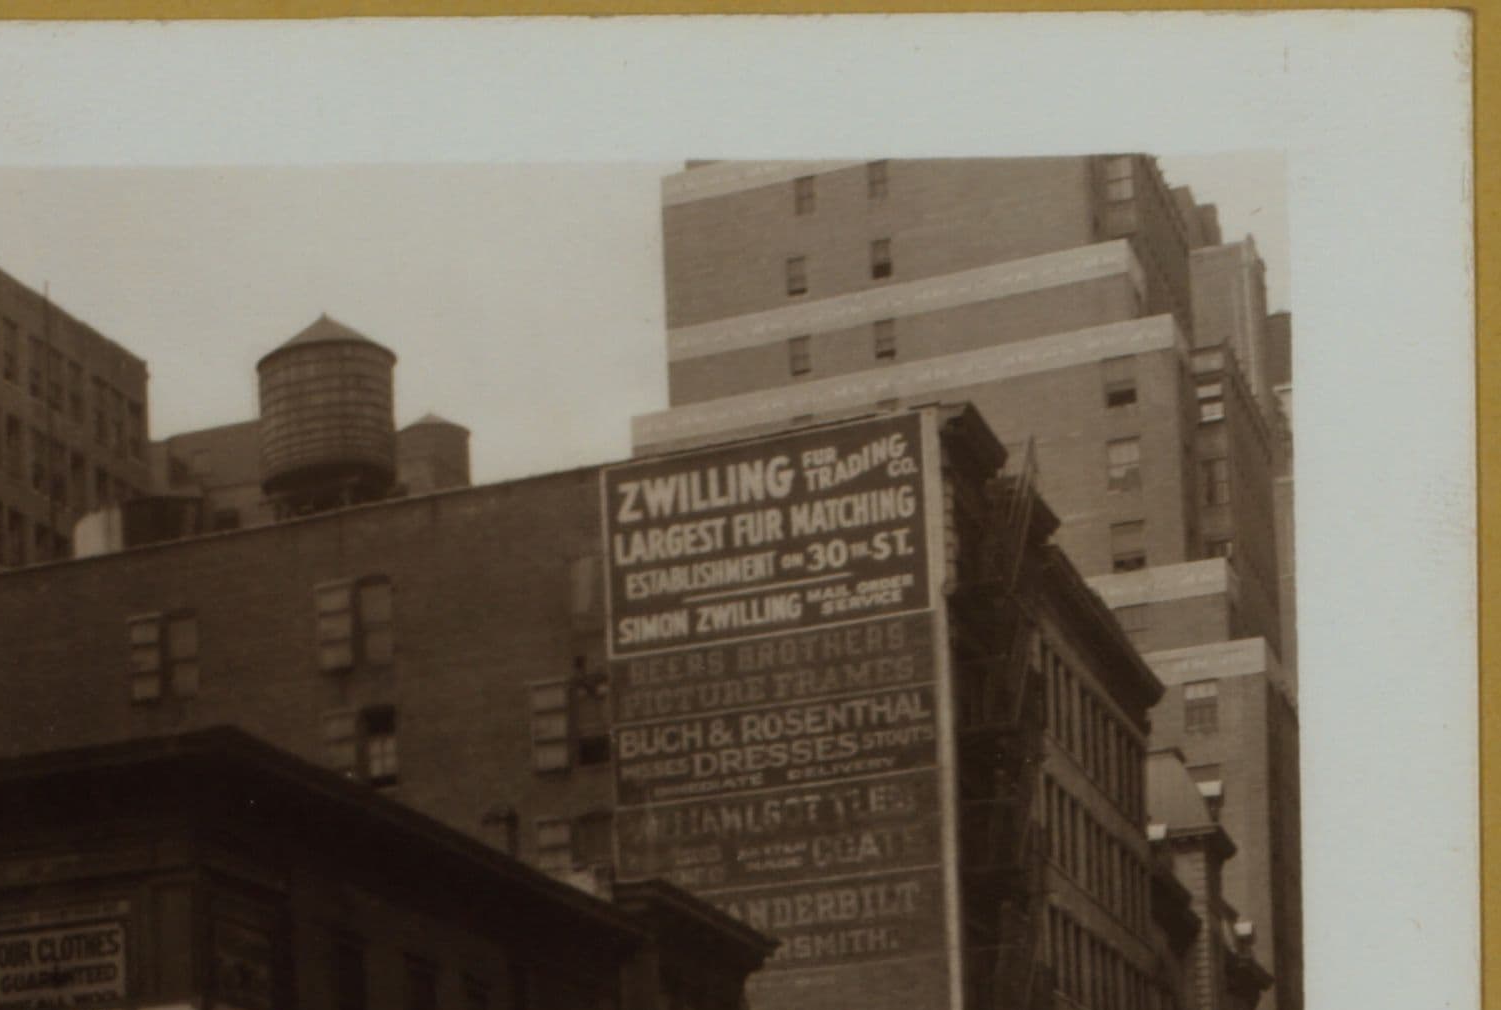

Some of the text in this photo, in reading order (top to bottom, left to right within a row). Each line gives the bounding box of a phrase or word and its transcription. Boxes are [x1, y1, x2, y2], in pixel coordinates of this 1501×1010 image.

[616, 447, 837, 524] ZWILLING FUR
[804, 433, 906, 491] TRADING
[613, 485, 916, 566] LARGEST FUR MATCHING
[624, 550, 778, 602] ESTABLISHMENT
[617, 608, 691, 646] SIMON
[696, 592, 804, 634] ZWILLING
[736, 621, 906, 673] BROTHERS
[619, 655, 915, 720] PICTURE FRAMES
[618, 693, 931, 760] BUCH & ROSENTHAL
[620, 725, 936, 781] MISSES DRESSES STOUTS
[654, 756, 897, 798] IMMEDIATE DELIVERY
[36, 927, 121, 961] CLOTHES
